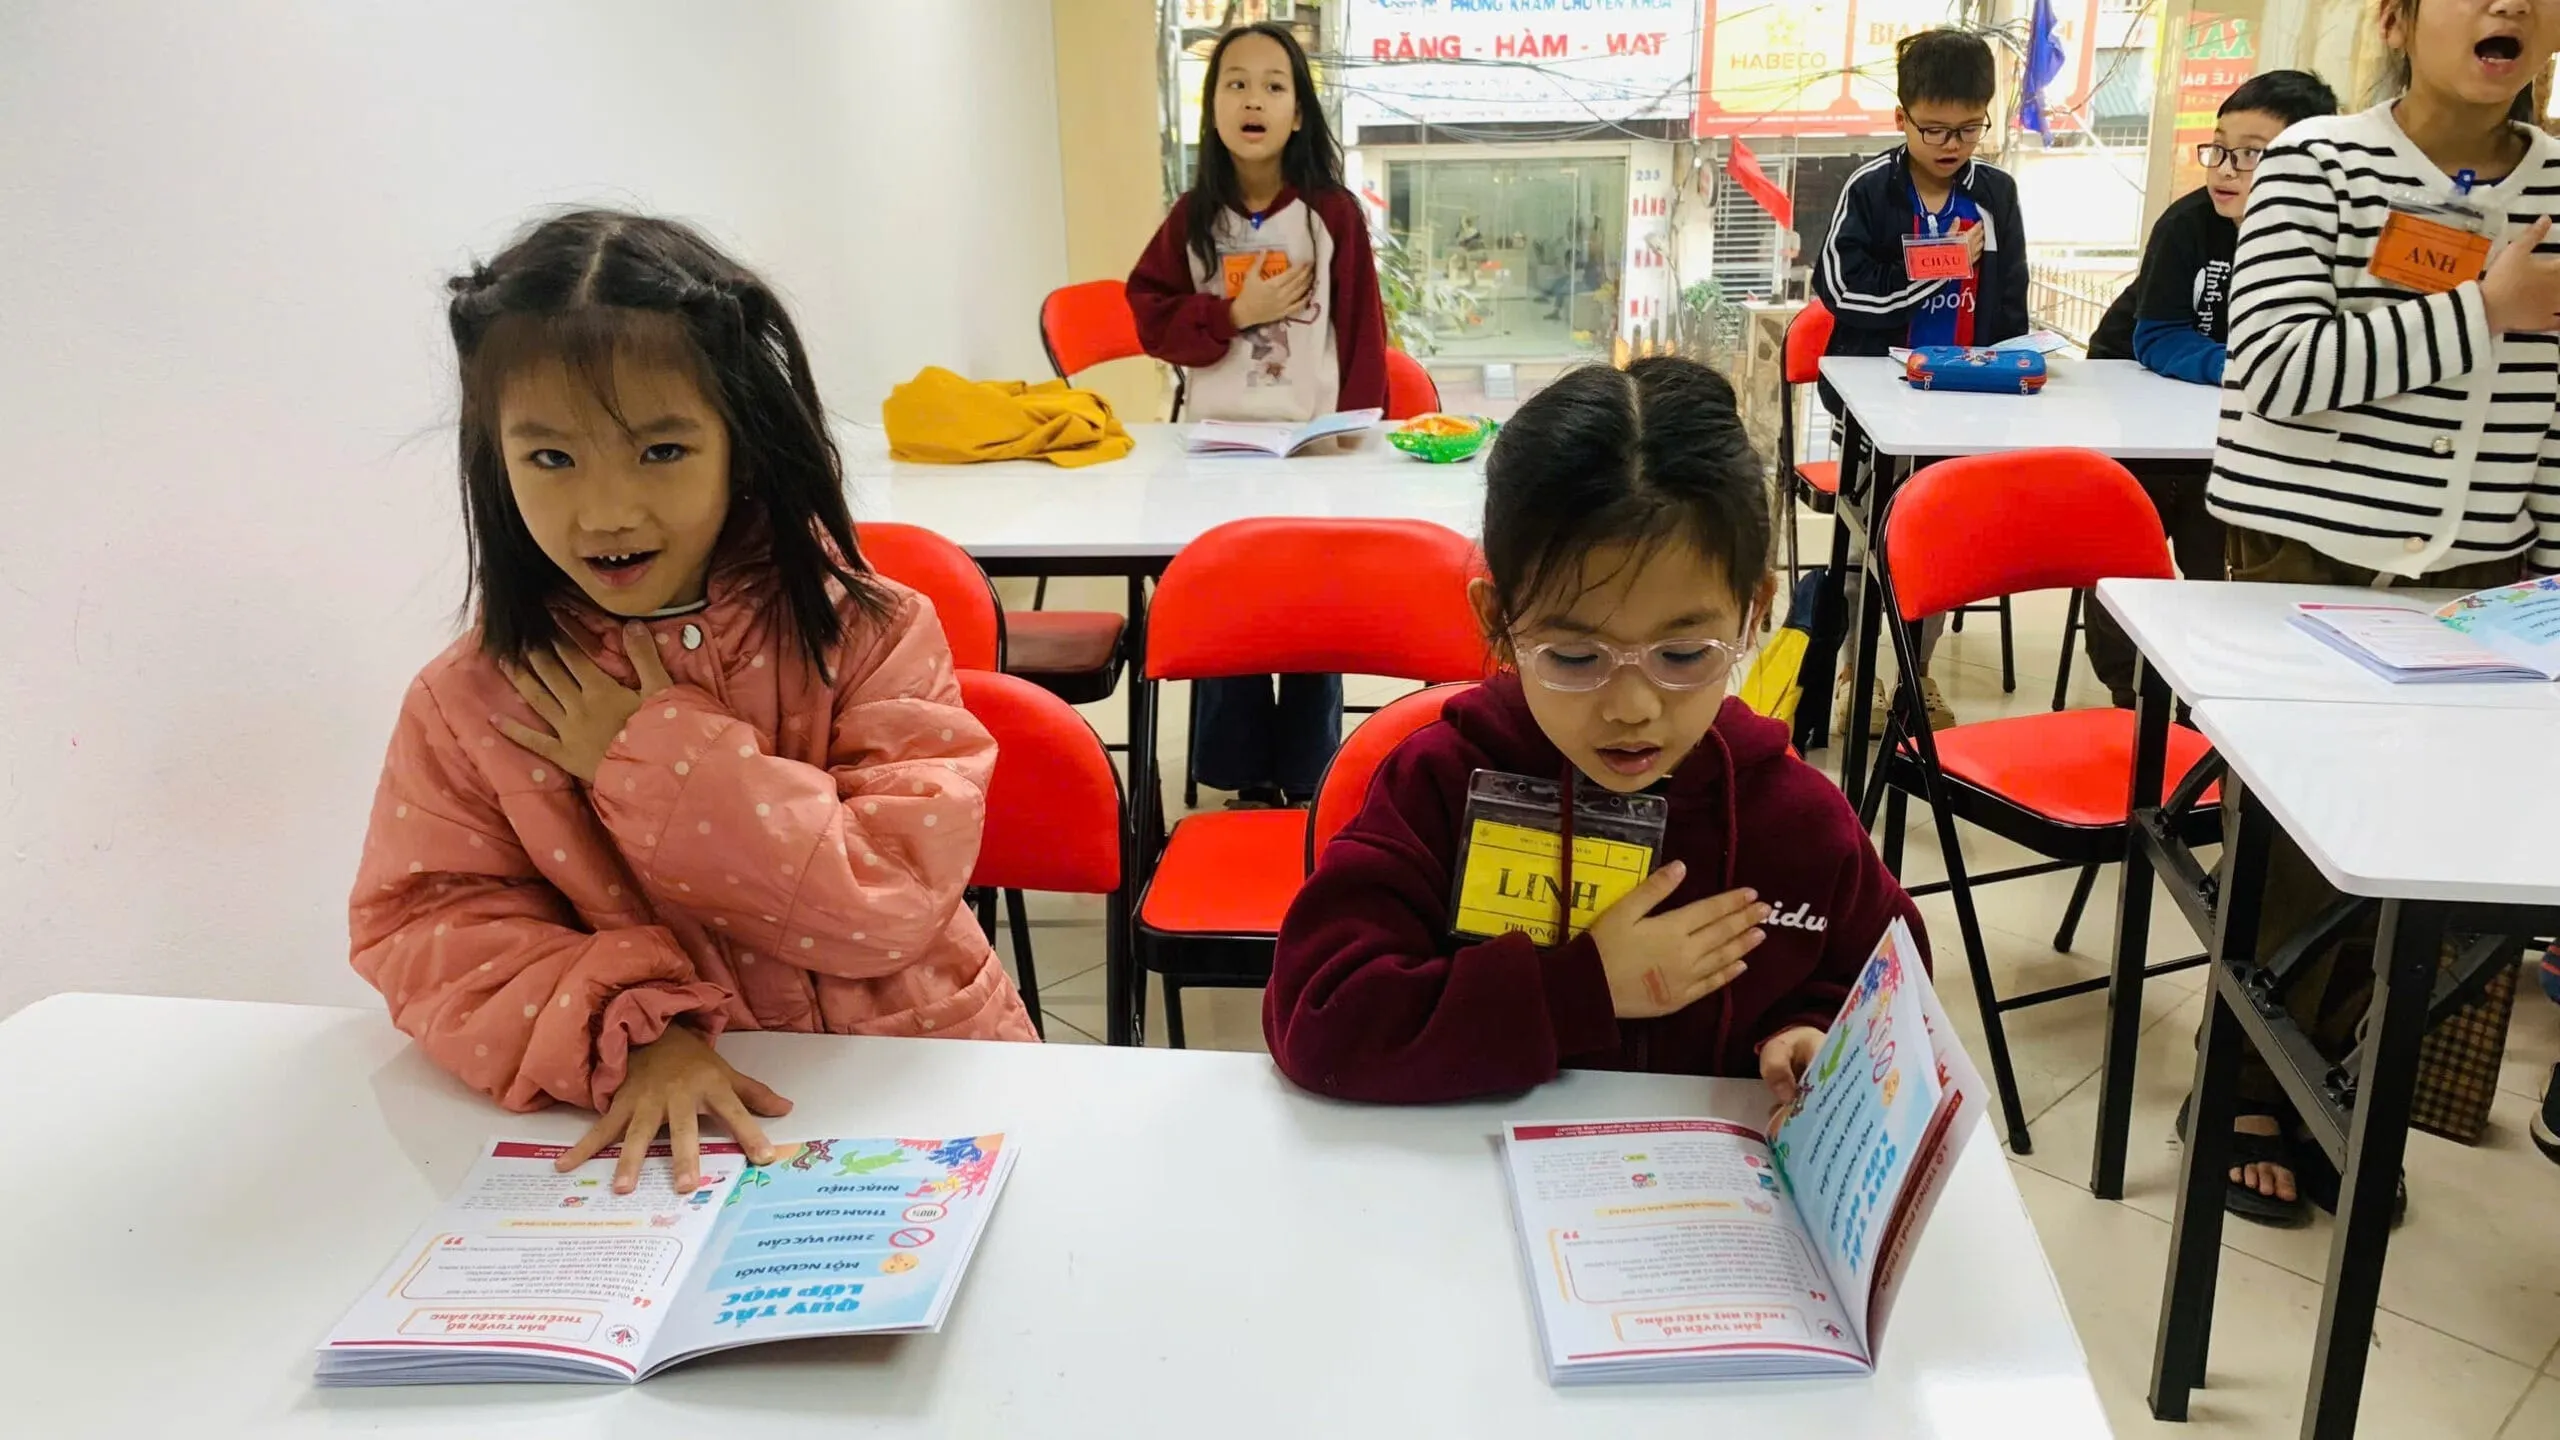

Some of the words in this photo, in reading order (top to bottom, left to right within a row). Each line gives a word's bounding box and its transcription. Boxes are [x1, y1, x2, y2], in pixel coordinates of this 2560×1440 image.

[1373, 31, 1461, 60] RĂNG
[1495, 28, 1568, 58] HÀM
[1731, 52, 1827, 70] HABECO
[1635, 169, 1661, 181] 233
[2405, 246, 2458, 274] ANH
[1496, 867, 1601, 912] LINH
[1760, 901, 1828, 932] idu
[816, 1184, 855, 1195] HIỆU
[856, 1184, 900, 1194] NHẠC
[772, 1209, 811, 1220] 100%
[815, 1209, 840, 1218] GIA
[842, 1209, 886, 1217] THAM
[790, 1233, 825, 1245] VỰC
[827, 1234, 863, 1242] KHU
[734, 1266, 766, 1279] NÓI
[767, 1262, 821, 1276] NGƯỜI
[824, 1260, 860, 1272] MỘT
[721, 1286, 792, 1306] HỌC
[797, 1283, 864, 1300] LỚP
[785, 1298, 860, 1315] QUY
[713, 1304, 777, 1329] TẮC
